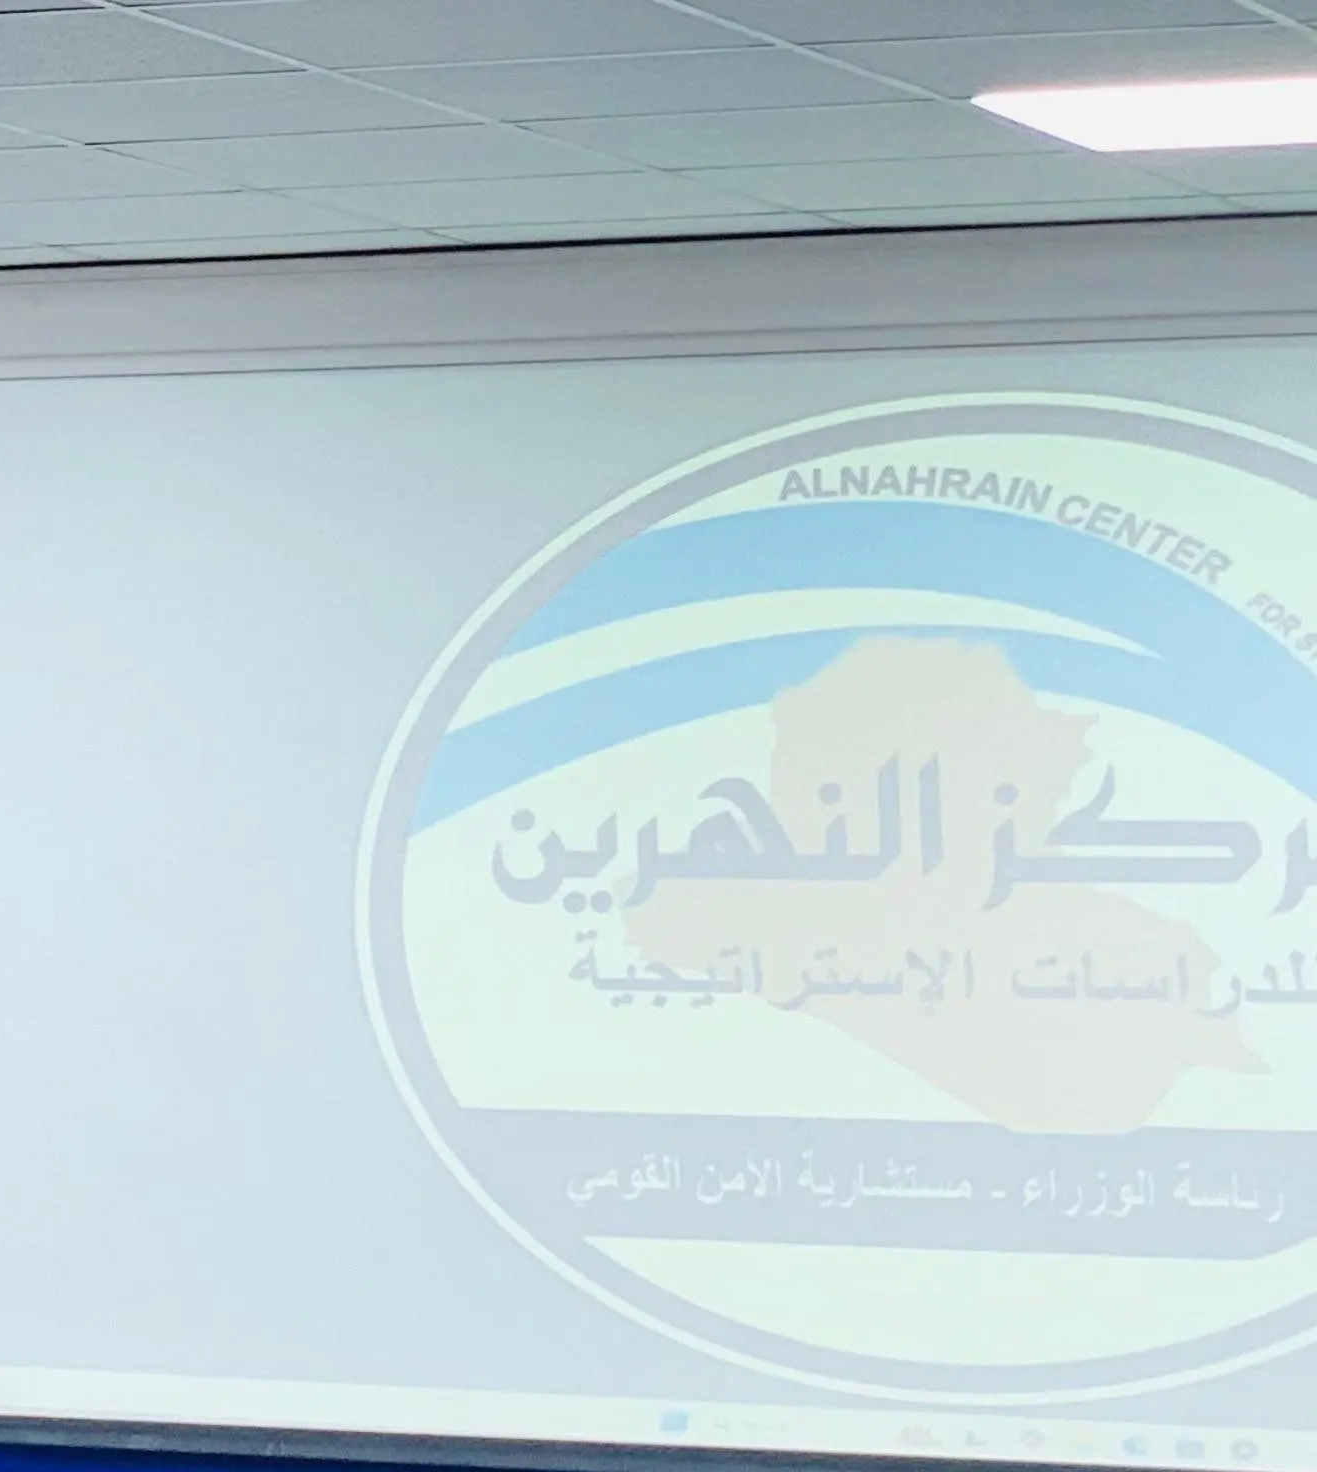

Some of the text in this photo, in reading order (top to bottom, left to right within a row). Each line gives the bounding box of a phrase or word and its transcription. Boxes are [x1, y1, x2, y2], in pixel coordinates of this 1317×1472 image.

[778, 465, 1053, 513] ALNAHRAIN
[1056, 495, 1234, 584] CENTER
[1245, 592, 1302, 638] FOR
[492, 751, 1317, 915] ركز النهرين
[567, 1152, 680, 1208] القومي
[799, 1149, 971, 1208] مستشارية
[1023, 1168, 1155, 1218] الوزراء
